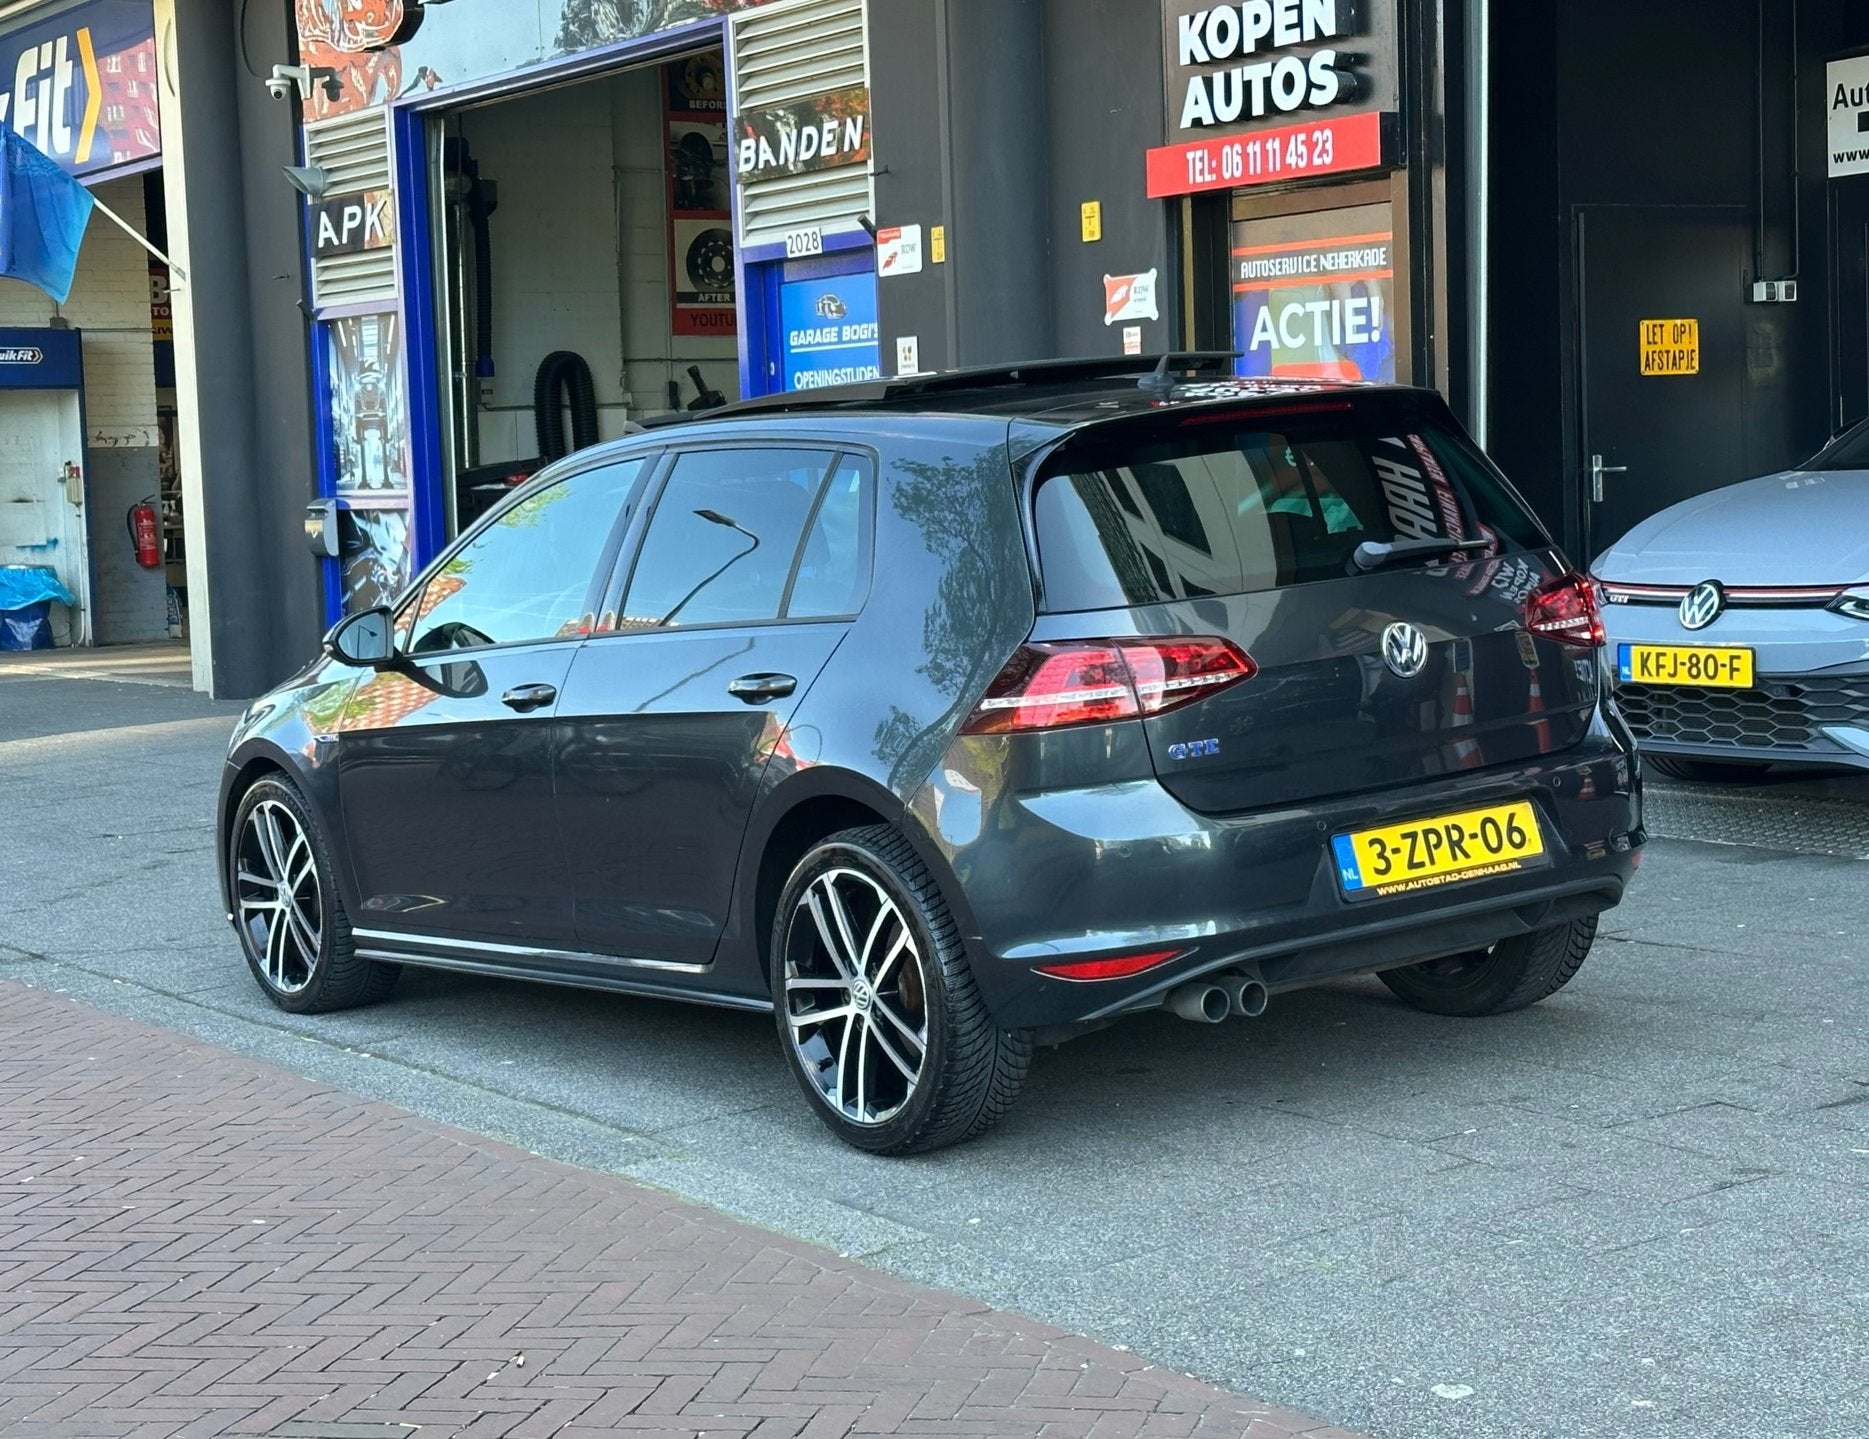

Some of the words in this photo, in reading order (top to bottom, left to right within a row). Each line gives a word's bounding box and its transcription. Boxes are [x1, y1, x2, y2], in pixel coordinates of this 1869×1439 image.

[1179, 0, 1337, 66] KOPEN
[689, 99, 727, 110] BEFOR
[1179, 49, 1340, 129] AUTOS
[738, 115, 864, 173] BANDEN
[1186, 149, 1217, 185] TEL:
[1222, 143, 1243, 180] 06
[1246, 140, 1262, 175] 11
[1266, 136, 1281, 173] 11
[1285, 133, 1308, 169] 45
[1312, 128, 1333, 166] 23
[317, 198, 385, 249] APK
[787, 231, 820, 254] 2028
[1240, 254, 1318, 279] AUTOSERVICE
[1319, 247, 1387, 271] NEHERKADE
[698, 293, 730, 302] AFTER
[790, 326, 838, 346] GARAGE
[1250, 296, 1381, 351] ACTIE!
[1646, 324, 1664, 345] LET
[1673, 323, 1691, 345] OP!
[1644, 349, 1696, 371] AFSTAPJE
[1640, 651, 1741, 681] KFJ-80-F
[1168, 738, 1220, 760] GTE
[1342, 867, 1358, 881] NL
[1368, 812, 1527, 876] 3-ZPR-06
[1376, 861, 1522, 896] WWW.AUTOSTAD-DENHAAG.NL
